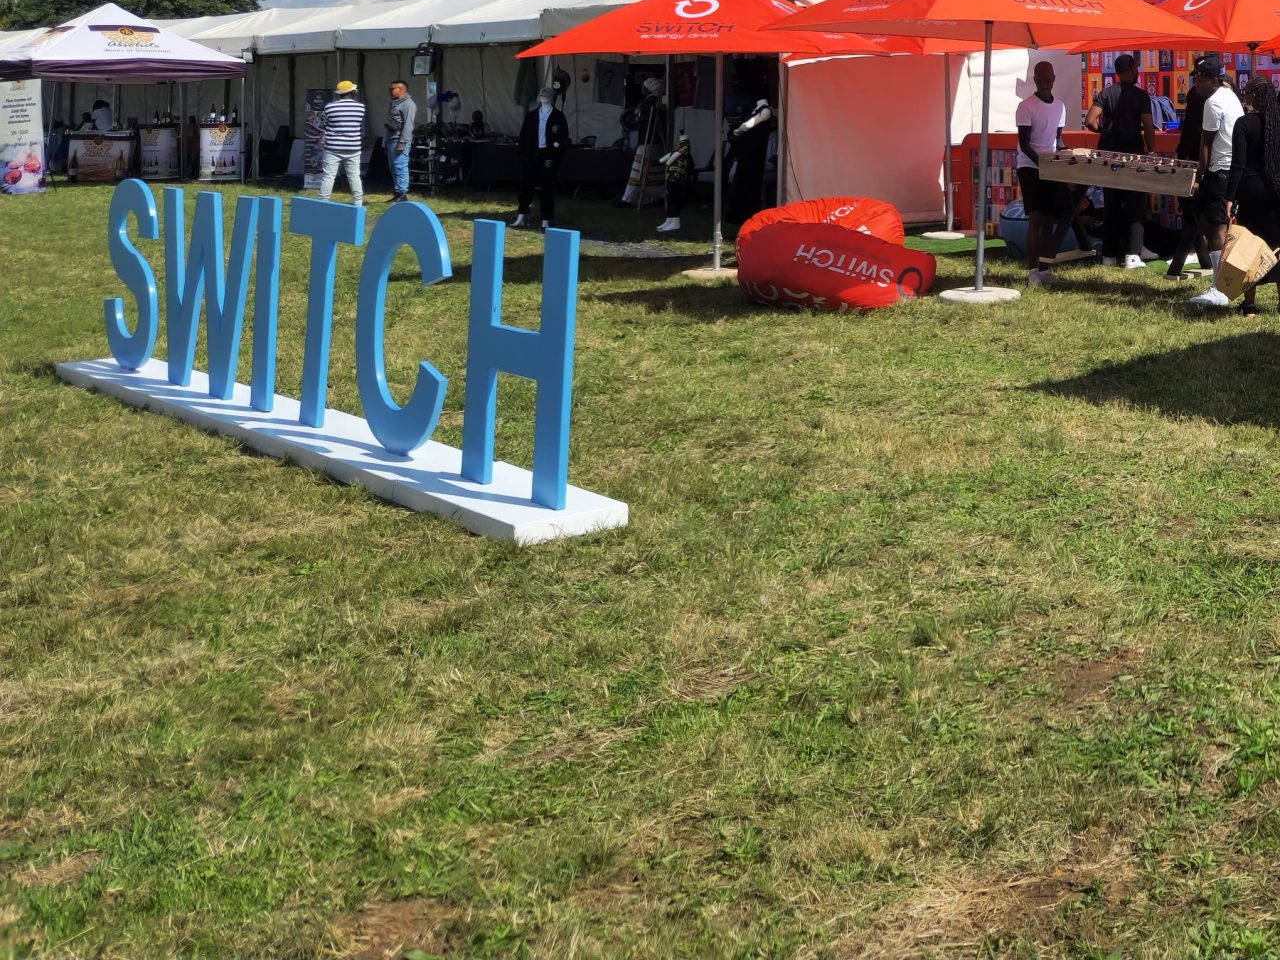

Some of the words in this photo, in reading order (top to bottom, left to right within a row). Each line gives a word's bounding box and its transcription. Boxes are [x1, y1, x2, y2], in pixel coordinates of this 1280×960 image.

[636, 22, 735, 33] SWITCH
[793, 243, 894, 288] SWITCH
[104, 178, 581, 511] SWITCH
